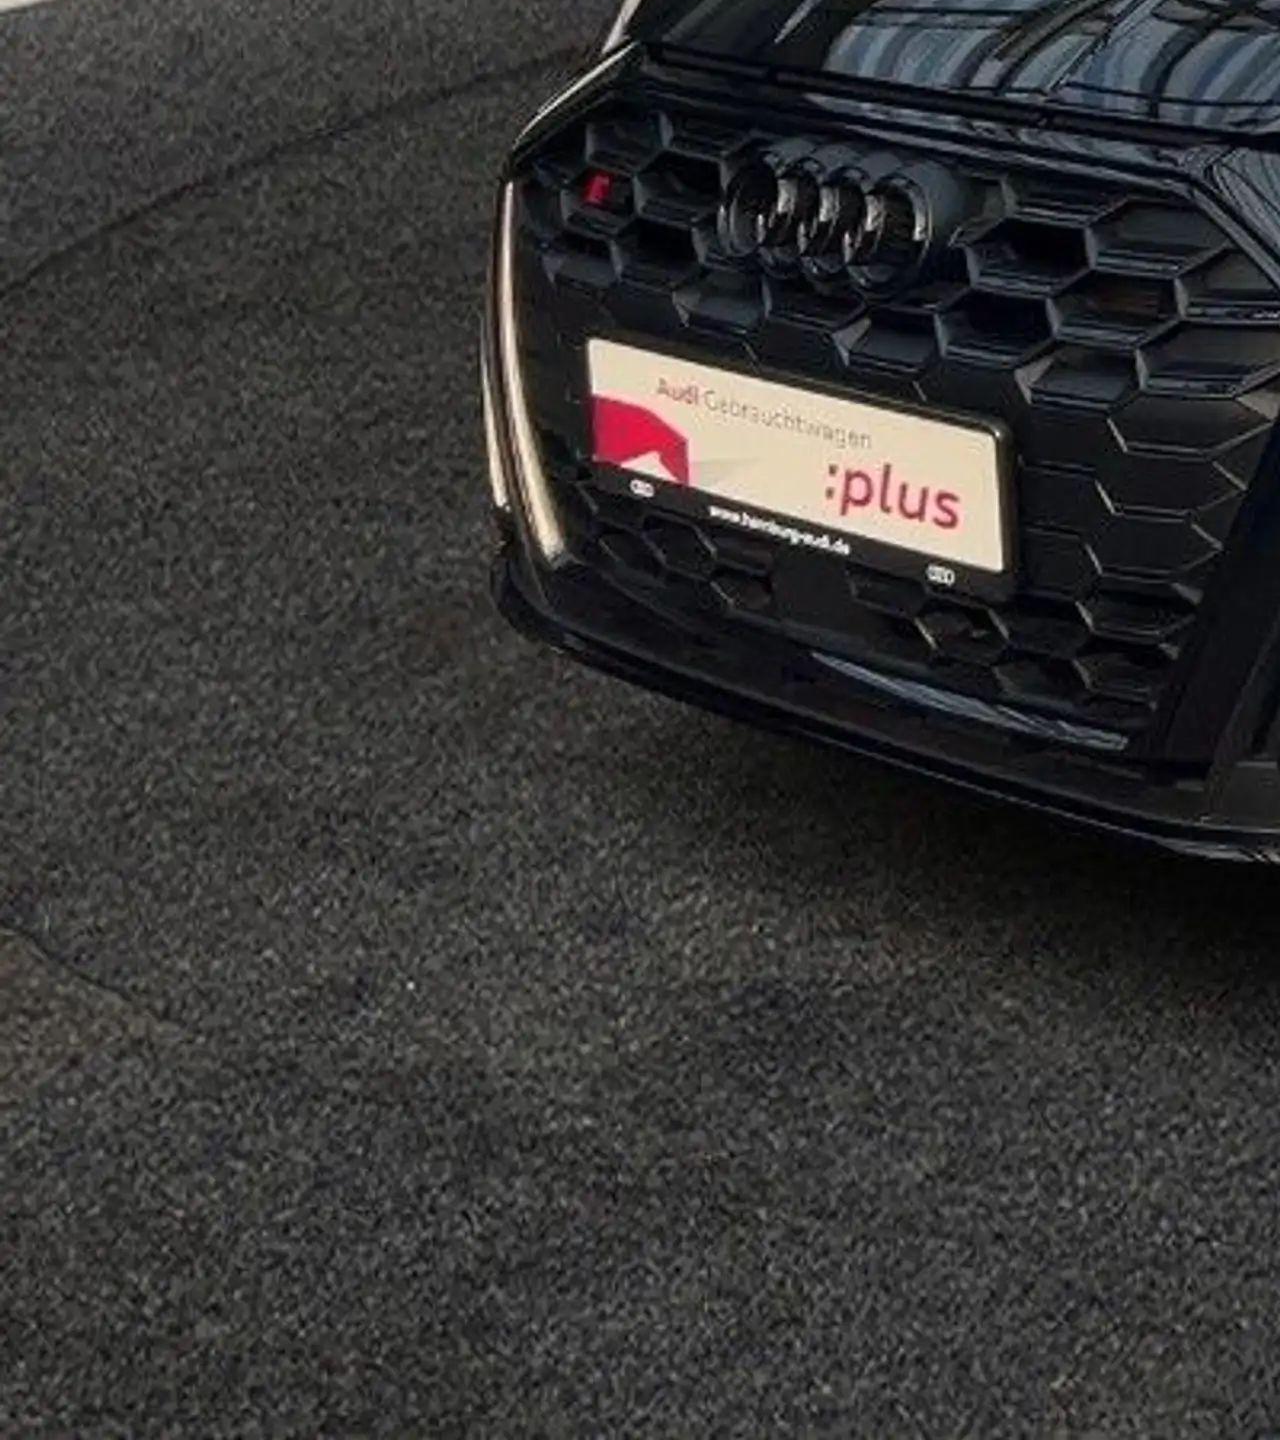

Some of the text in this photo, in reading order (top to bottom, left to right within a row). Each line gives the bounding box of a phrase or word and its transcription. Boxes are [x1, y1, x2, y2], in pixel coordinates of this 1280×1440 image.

[656, 377, 873, 449] Audi Gebrauchtwagen
[825, 463, 961, 530] :plus
